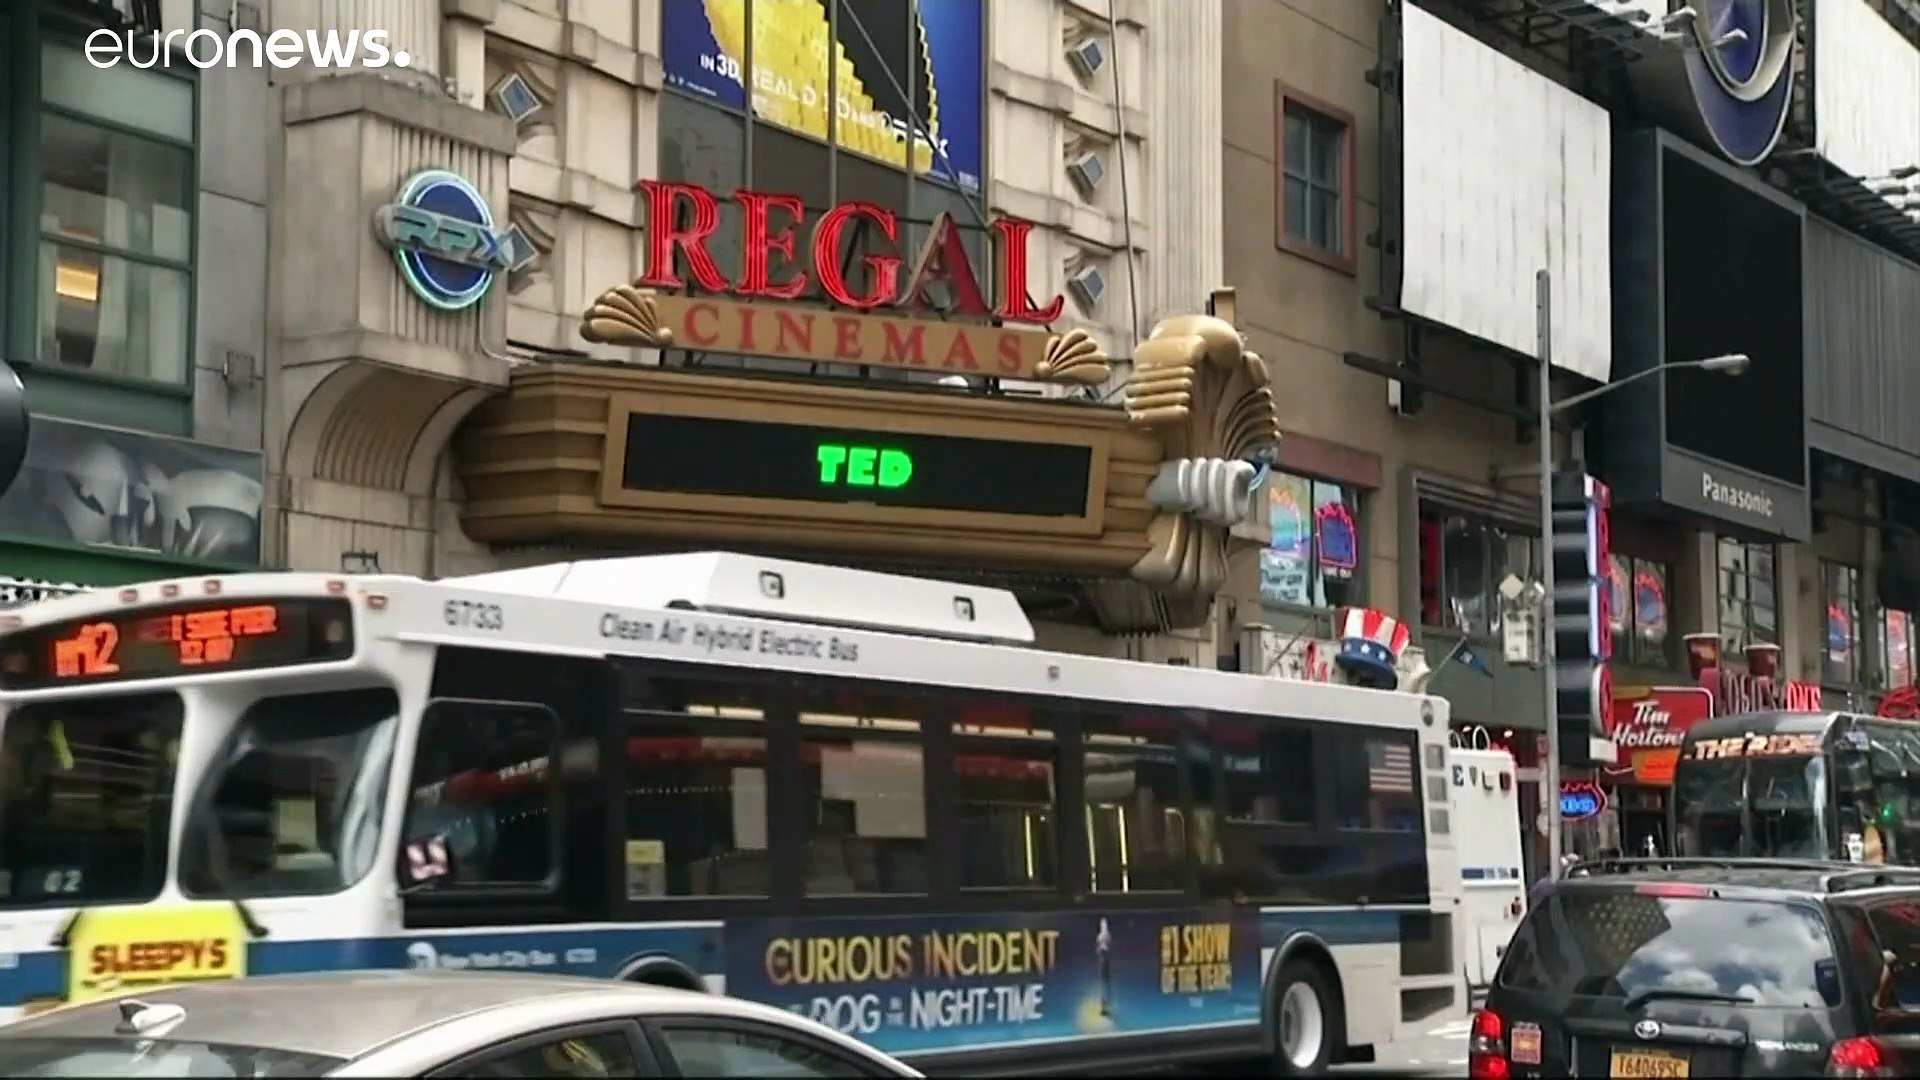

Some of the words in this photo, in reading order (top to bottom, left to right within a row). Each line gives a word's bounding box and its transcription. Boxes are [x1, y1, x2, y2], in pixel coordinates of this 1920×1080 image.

[390, 204, 517, 267] RPX
[638, 178, 1065, 325] REGAL
[684, 302, 1024, 375] CINEMAS
[817, 443, 913, 488] TED
[1702, 472, 1774, 518] Panasonic
[600, 612, 654, 641] Clean
[657, 619, 687, 644] Air
[693, 622, 754, 653] Hybrid
[758, 629, 823, 659] Electric
[828, 636, 859, 662] Bus
[1632, 700, 1672, 725] Tim
[764, 934, 913, 986] CURIOUS
[923, 928, 1060, 981] INCIDENT
[1182, 924, 1231, 963] SHOW
[810, 993, 882, 1034] DOG
[909, 983, 1044, 1032] NIGHT-TIME
